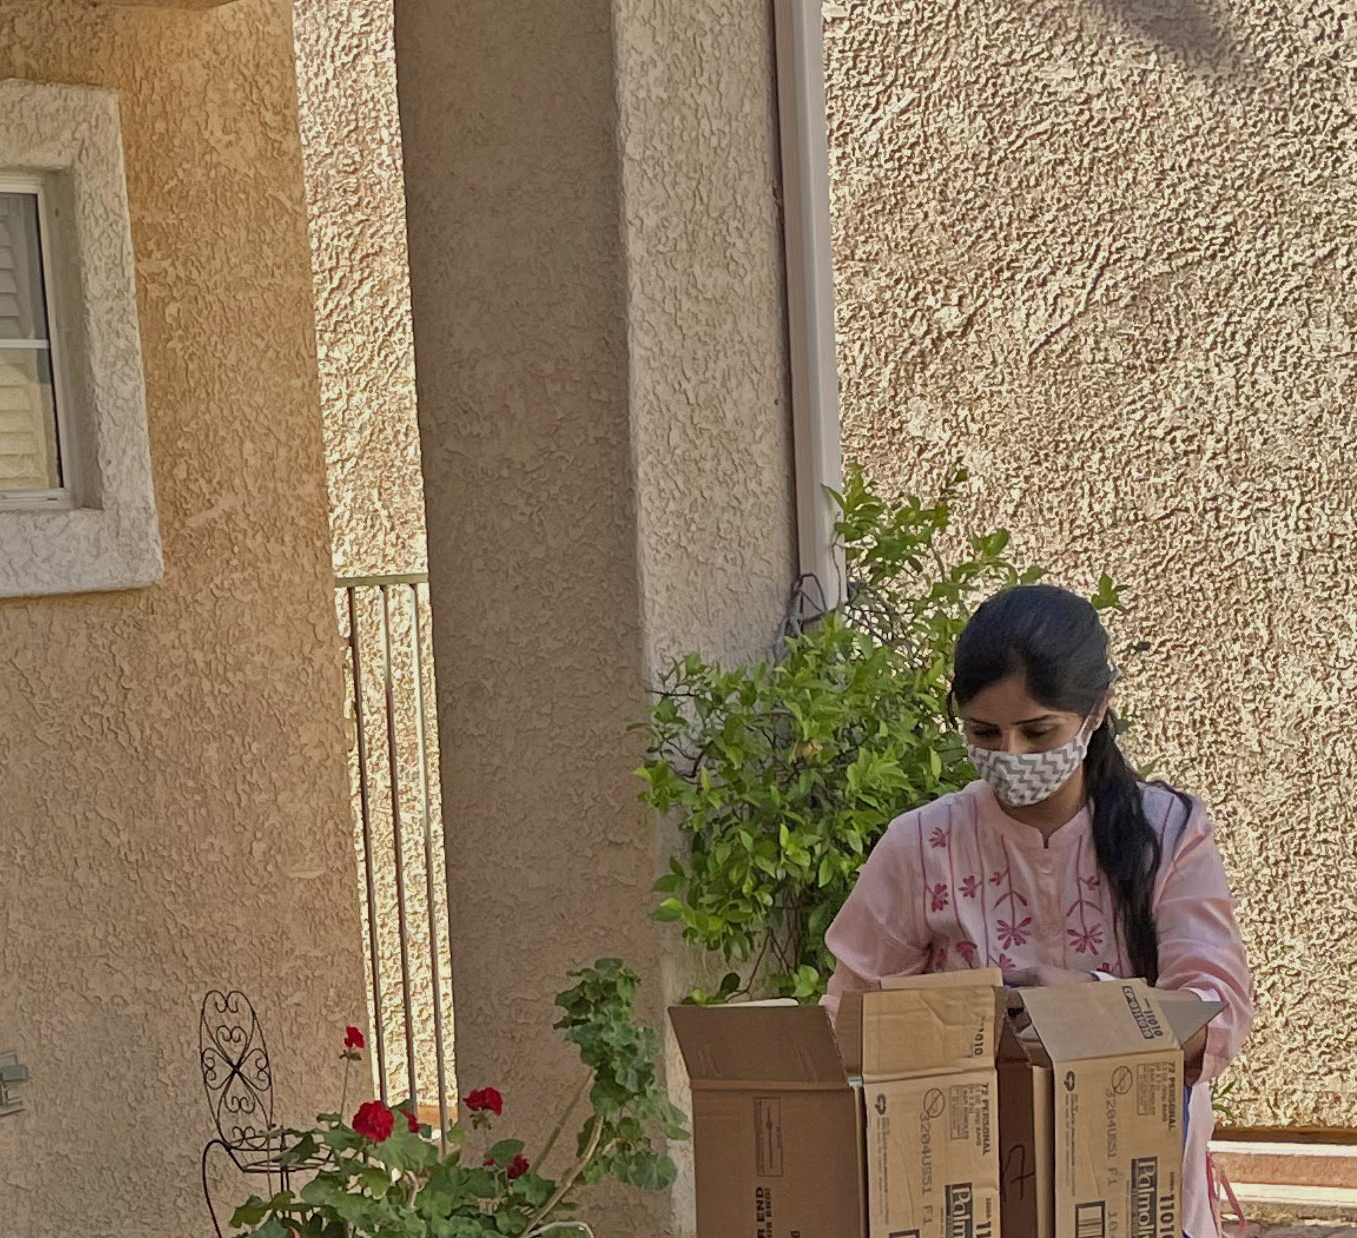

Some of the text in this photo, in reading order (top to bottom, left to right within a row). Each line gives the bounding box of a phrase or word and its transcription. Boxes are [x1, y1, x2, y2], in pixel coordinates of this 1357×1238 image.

[981, 1099, 990, 1156] PERSONAL
[1168, 1077, 1176, 1132] PERSONAL
[756, 1186, 764, 1222] END
